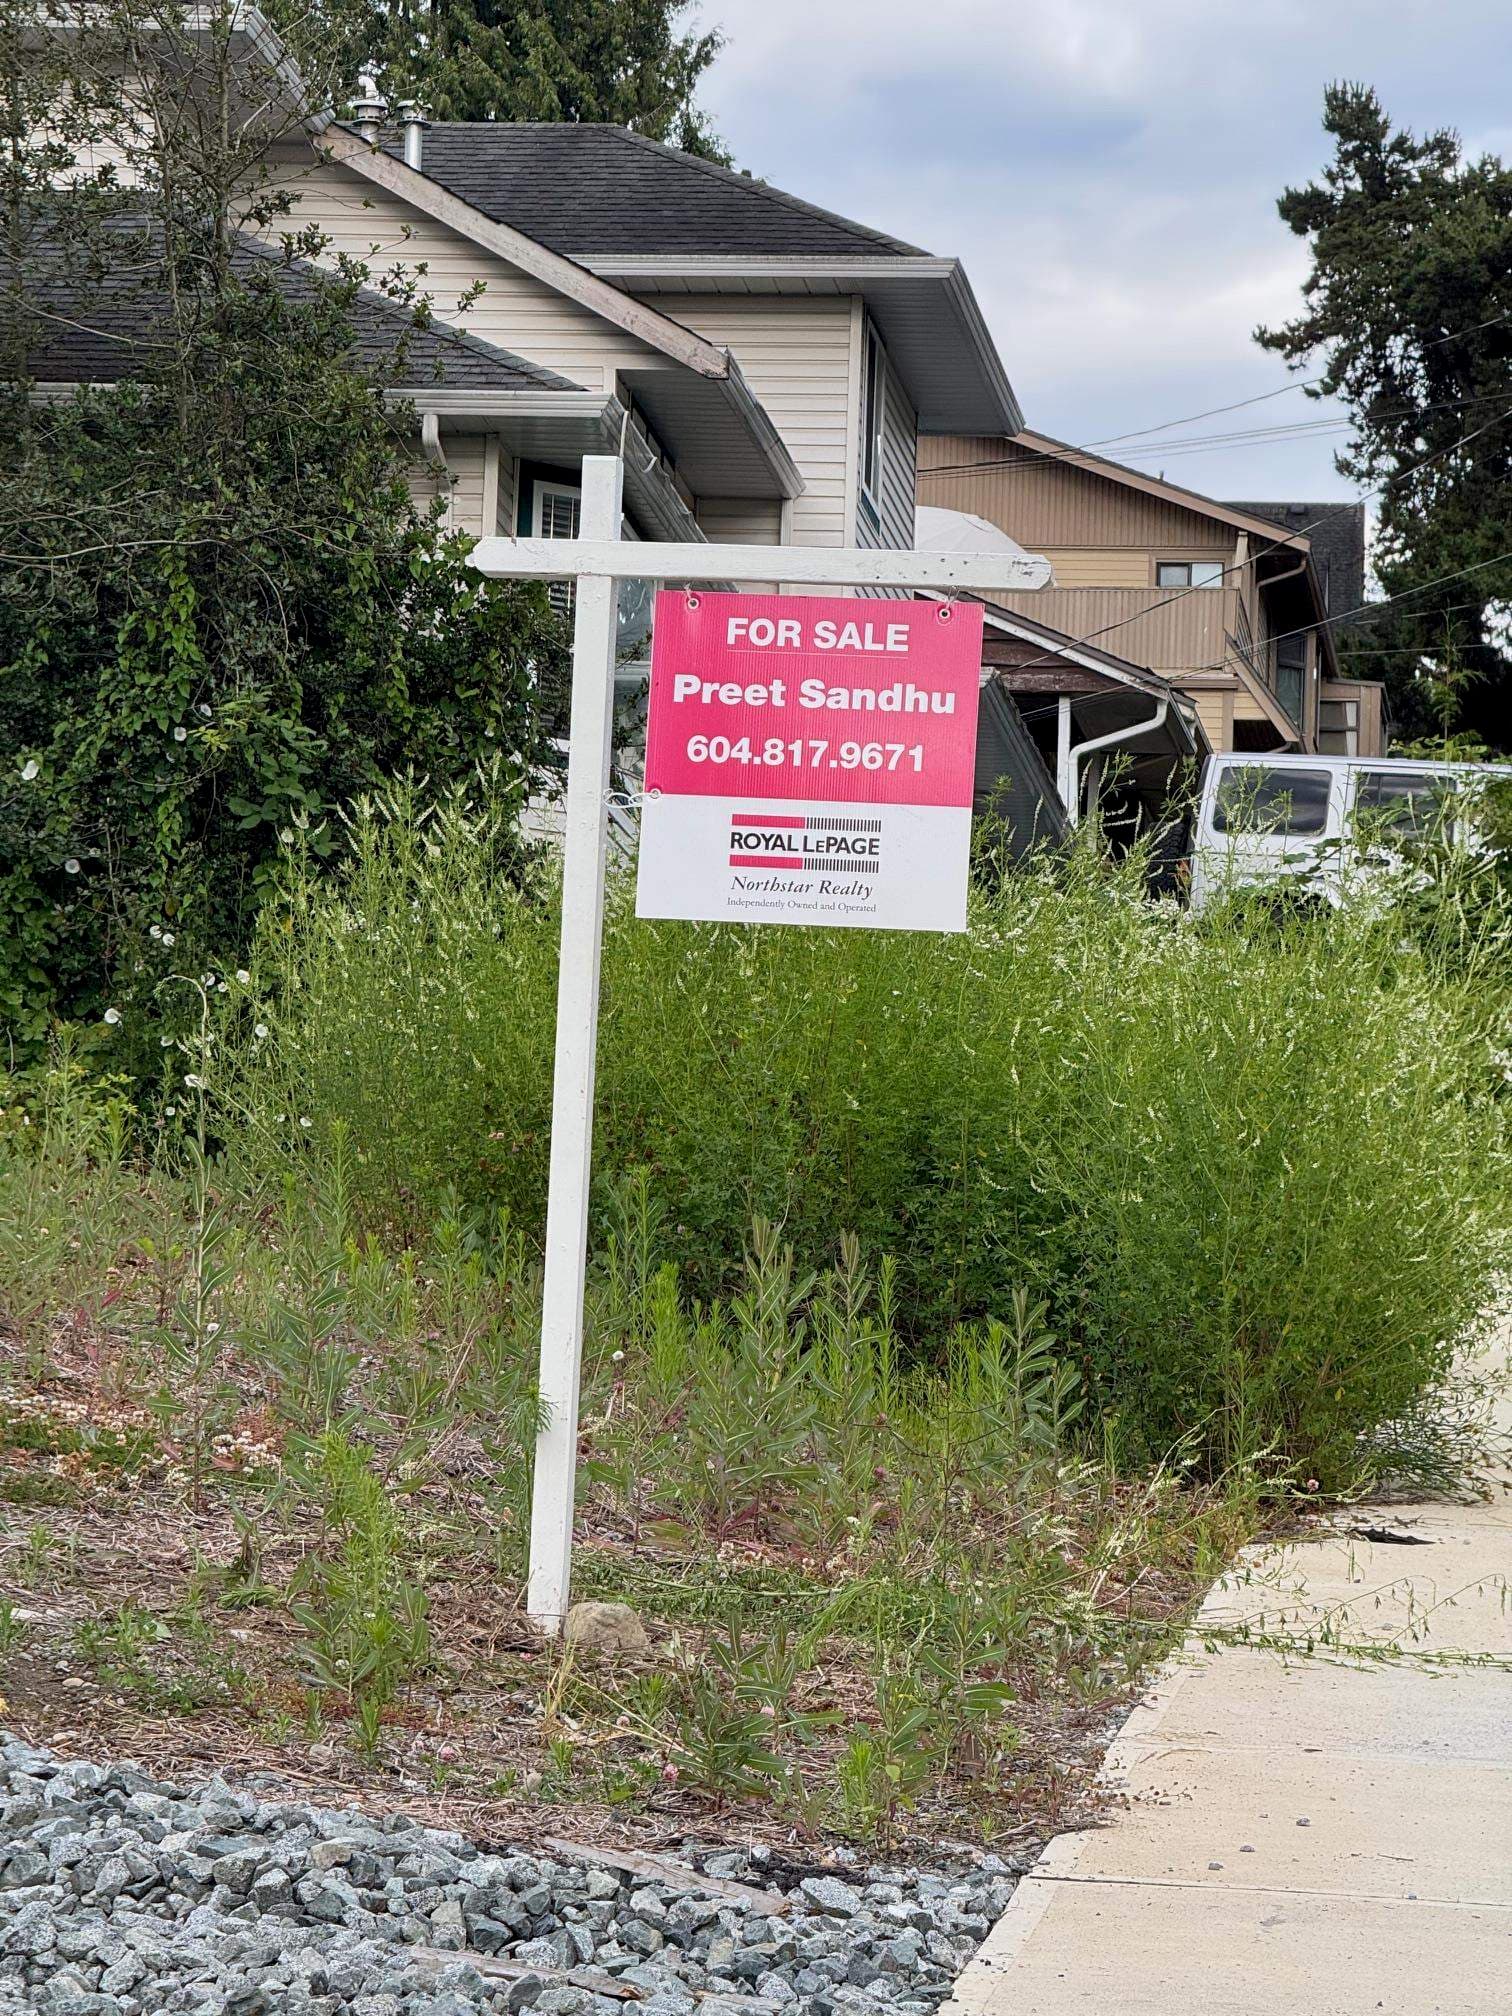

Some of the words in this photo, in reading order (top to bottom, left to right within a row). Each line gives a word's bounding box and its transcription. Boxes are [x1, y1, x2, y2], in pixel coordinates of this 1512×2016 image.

[726, 617, 802, 647] FOR
[812, 620, 910, 652] SALE
[673, 673, 787, 707] Preet
[798, 678, 956, 714] Sandhu
[686, 734, 924, 772] 604.817.9671
[730, 831, 799, 852] ROYAL
[730, 875, 814, 894] Northstar
[819, 879, 873, 901] Realty
[727, 896, 785, 909] Independently
[787, 899, 818, 910] Owned
[820, 901, 836, 911] and
[837, 902, 877, 914] Operated
